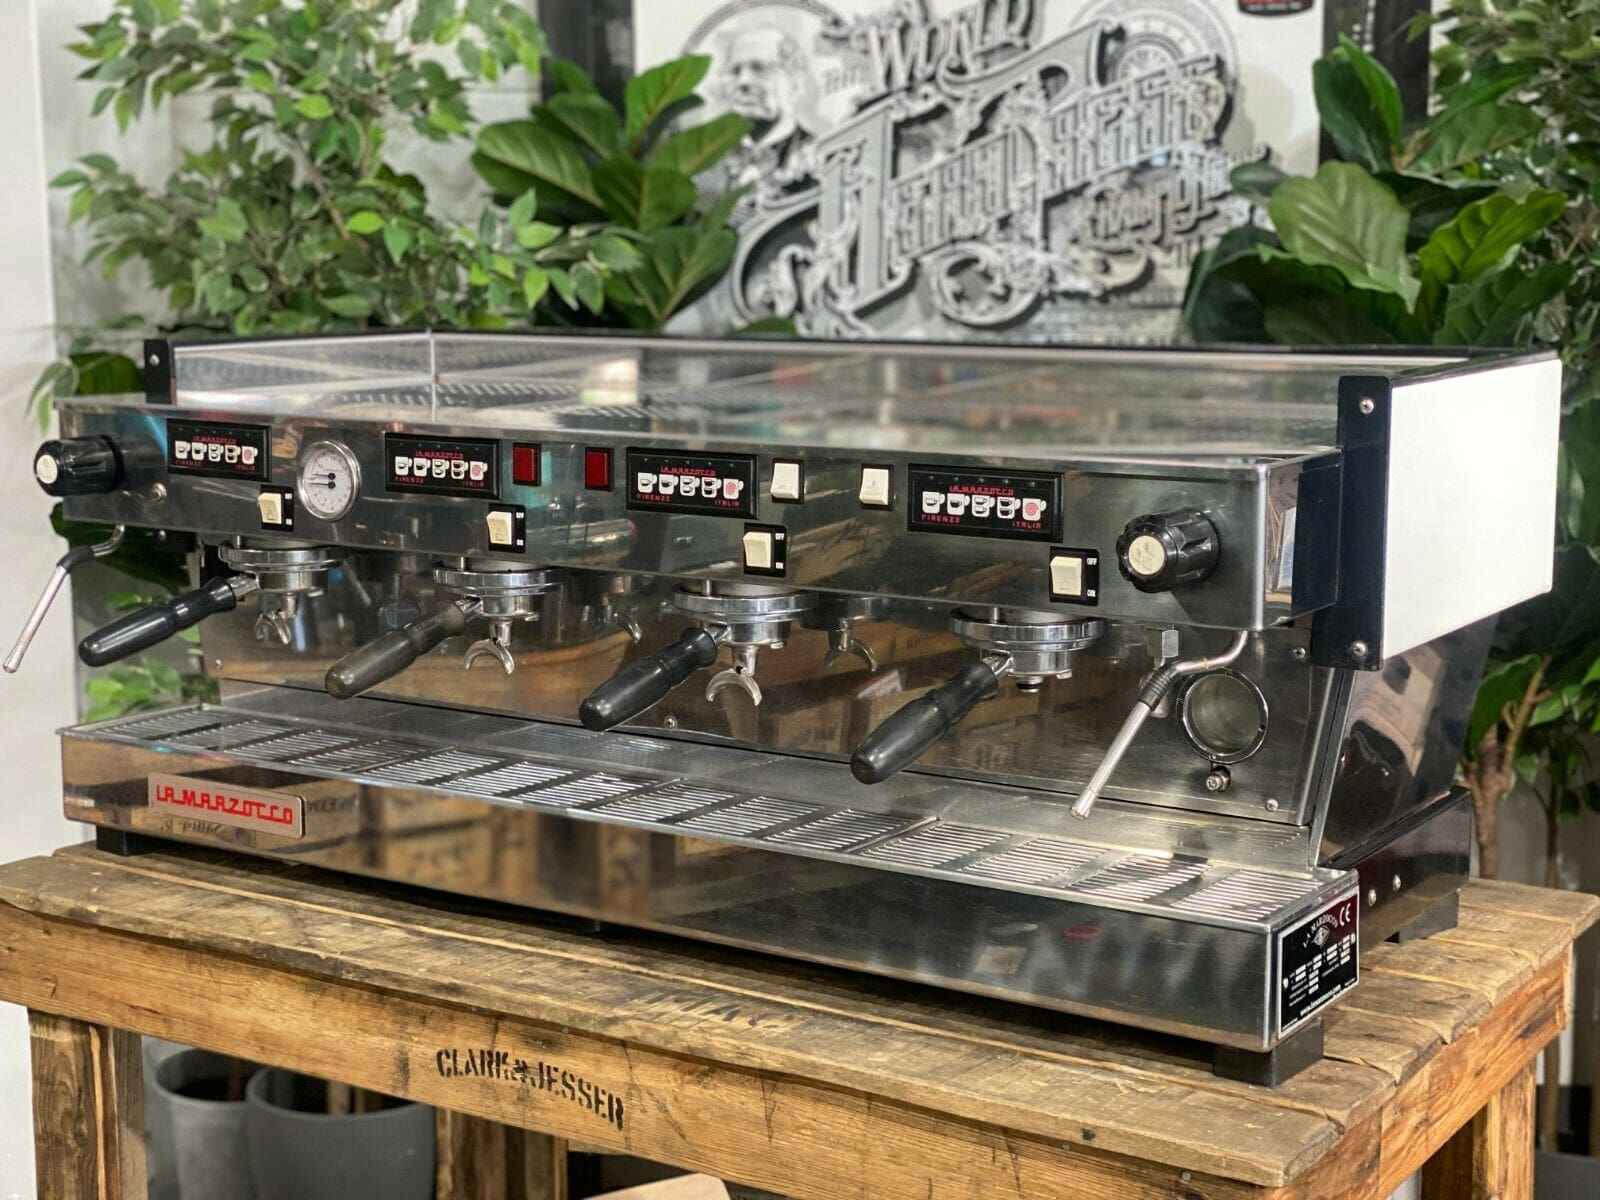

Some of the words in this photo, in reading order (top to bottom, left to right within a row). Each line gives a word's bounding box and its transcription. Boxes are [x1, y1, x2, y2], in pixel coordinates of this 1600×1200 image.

[637, 493, 670, 502] FIRENZE
[921, 514, 961, 524] FIRENZE
[1012, 520, 1042, 530] ITALIA
